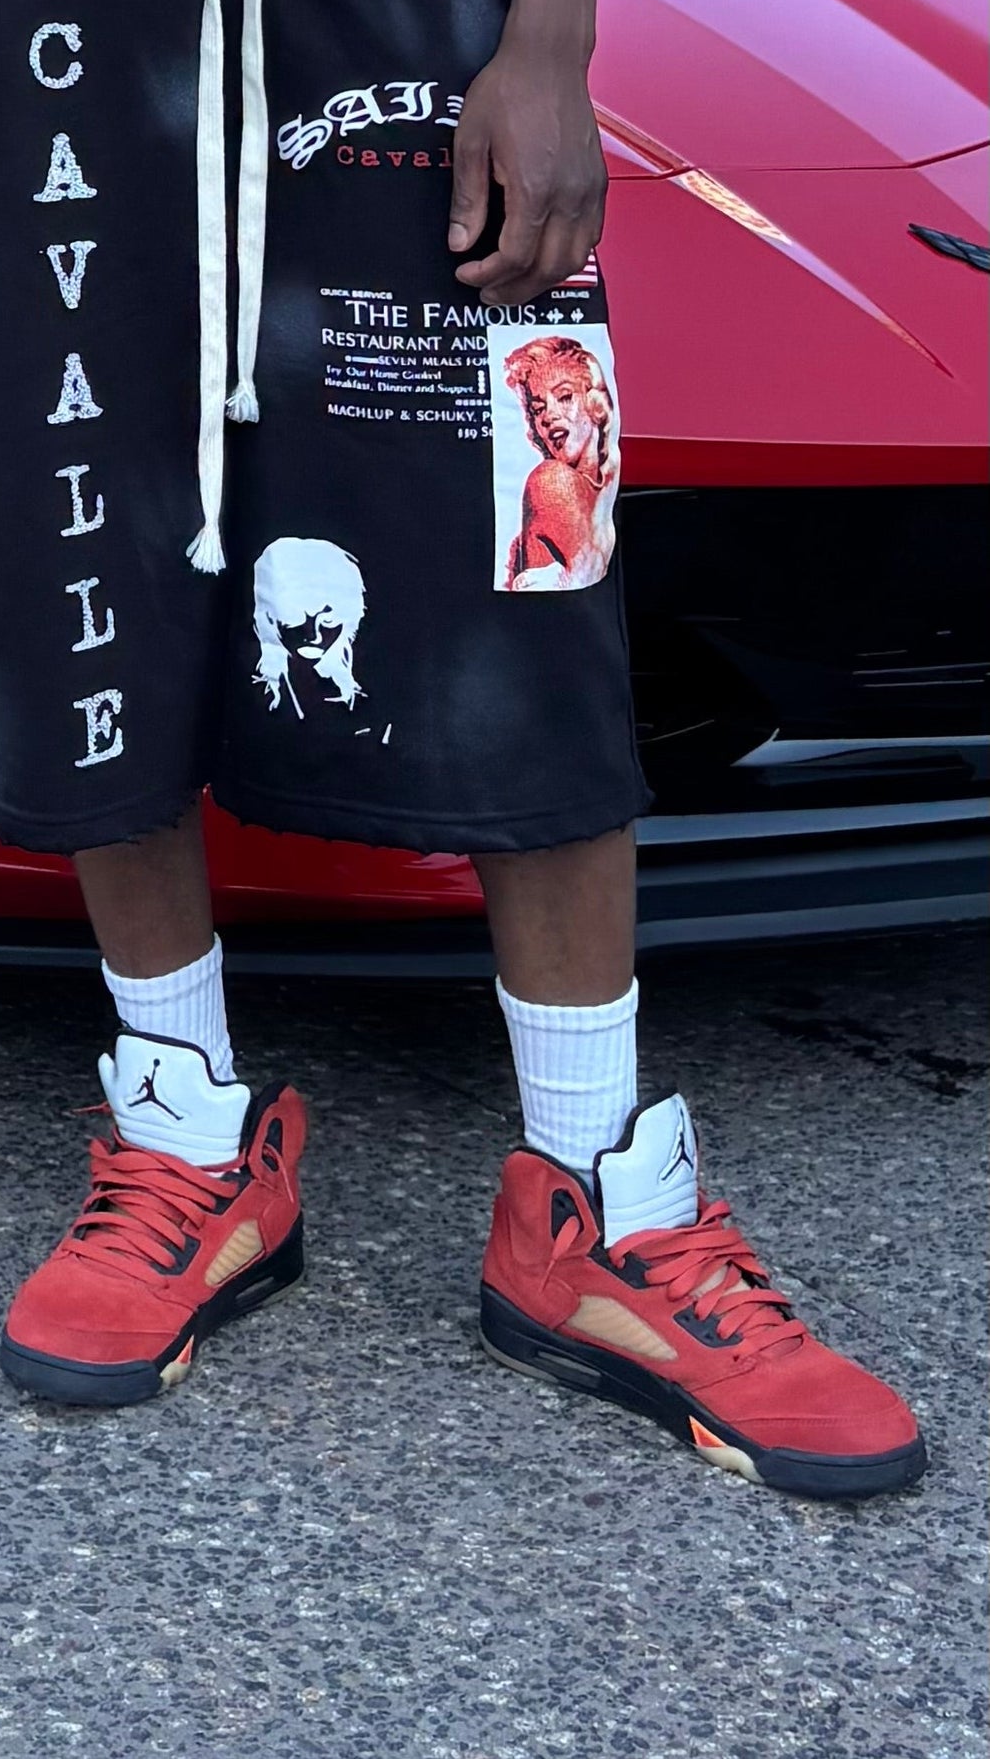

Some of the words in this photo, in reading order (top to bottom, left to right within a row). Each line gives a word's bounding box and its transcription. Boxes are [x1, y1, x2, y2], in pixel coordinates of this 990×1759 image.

[345, 299, 408, 328] THE
[423, 302, 536, 328] FAMOUS
[321, 328, 442, 351] RESTAURANT
[451, 336, 488, 351] AND
[28, 22, 125, 769] CAVALLE
[415, 383, 434, 393] and
[328, 403, 394, 420] MACHLUP
[400, 410, 410, 421] &
